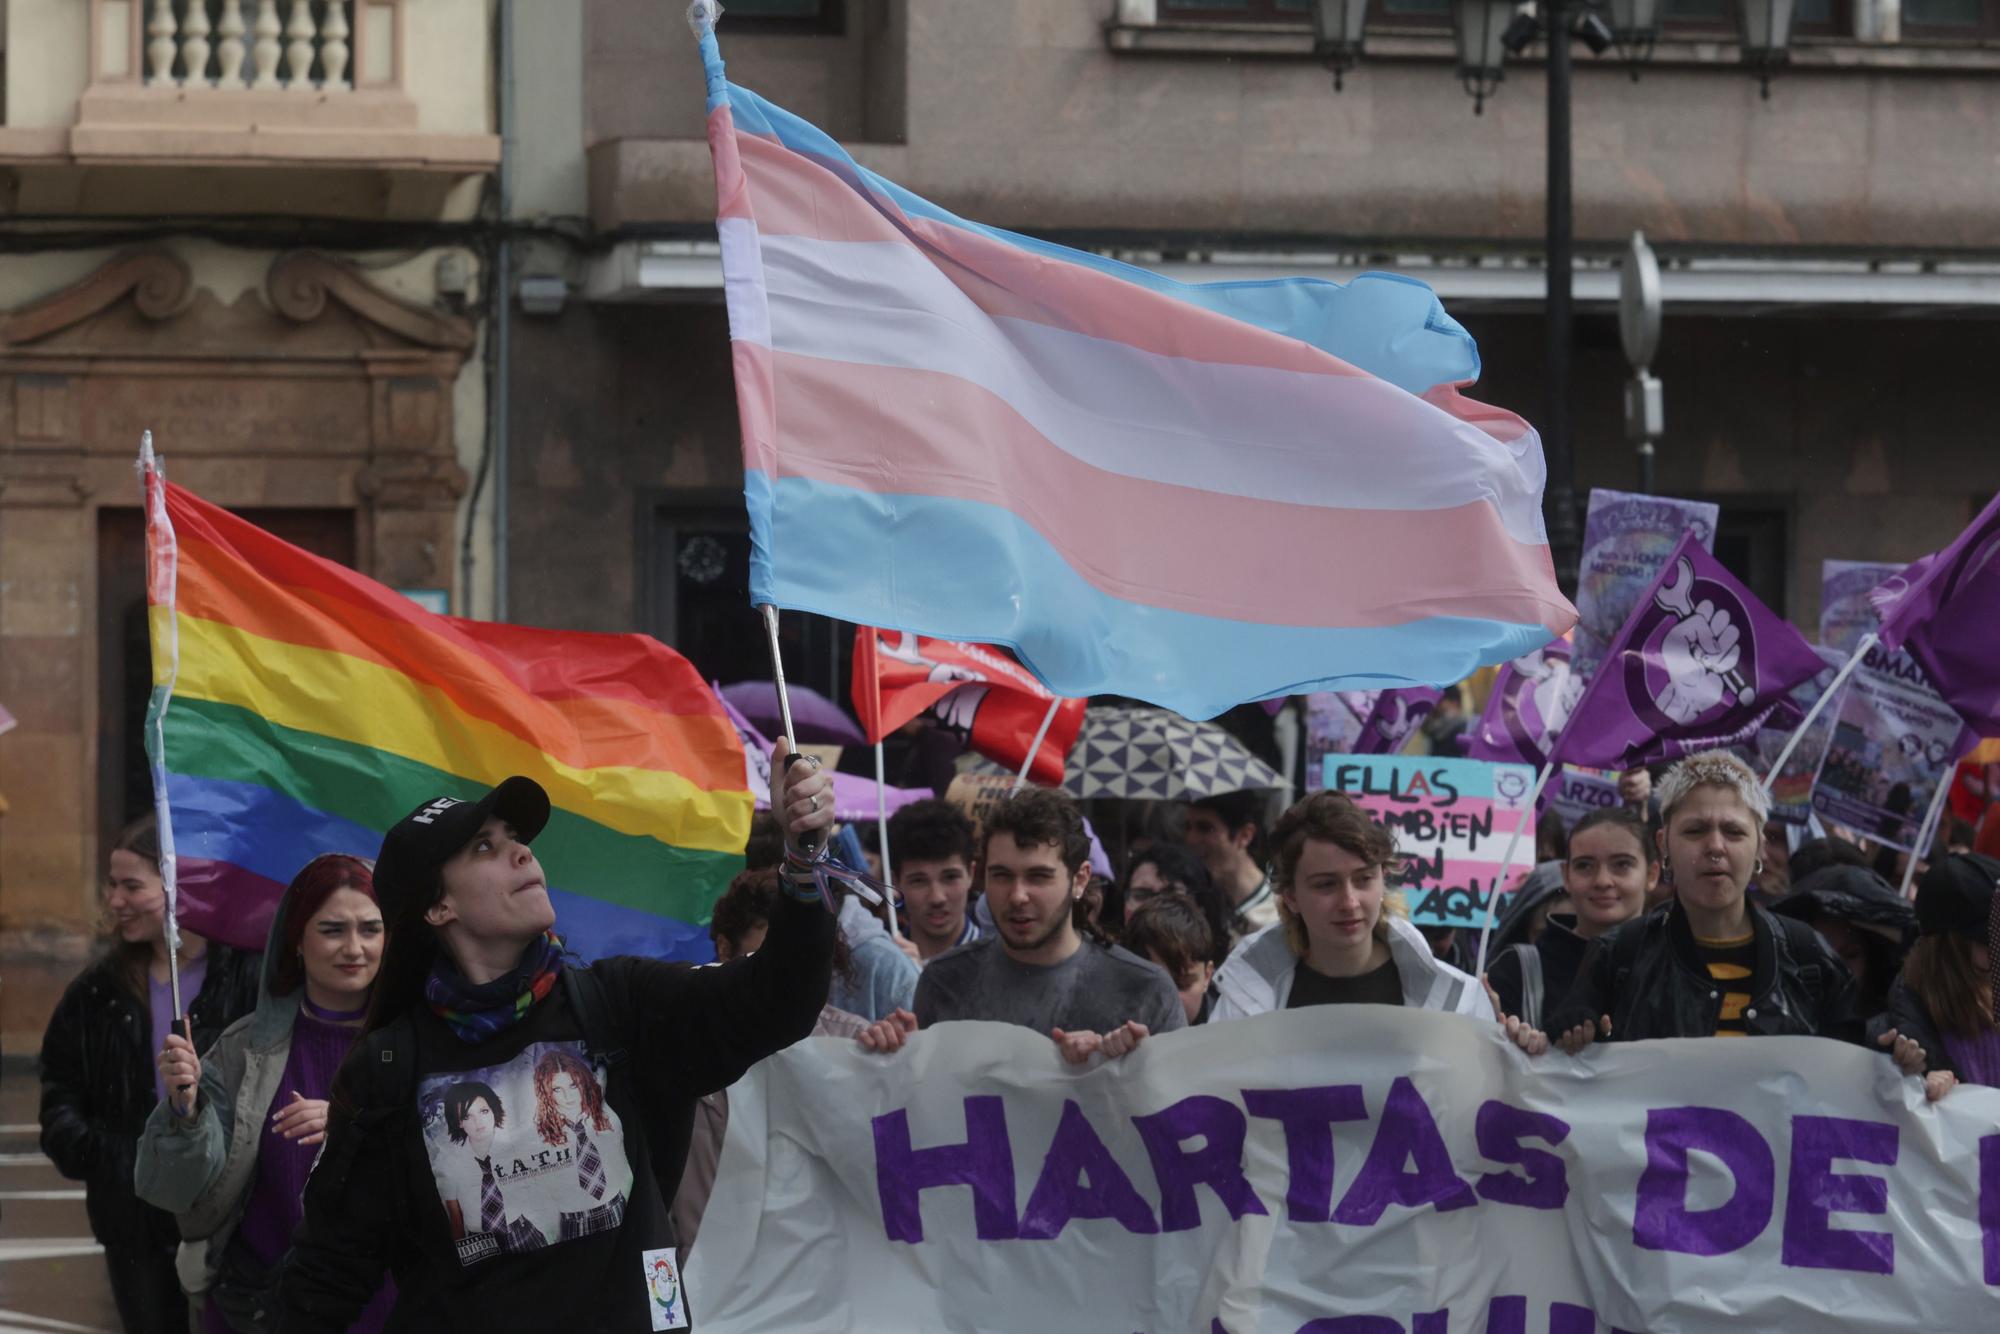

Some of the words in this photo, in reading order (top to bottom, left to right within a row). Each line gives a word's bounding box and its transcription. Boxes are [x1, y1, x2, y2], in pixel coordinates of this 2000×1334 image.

[1336, 765, 1458, 807] ELLAS
[412, 796, 468, 825] HE
[872, 1076, 1571, 1244] HARTAS
[1632, 1105, 1899, 1275] DE
